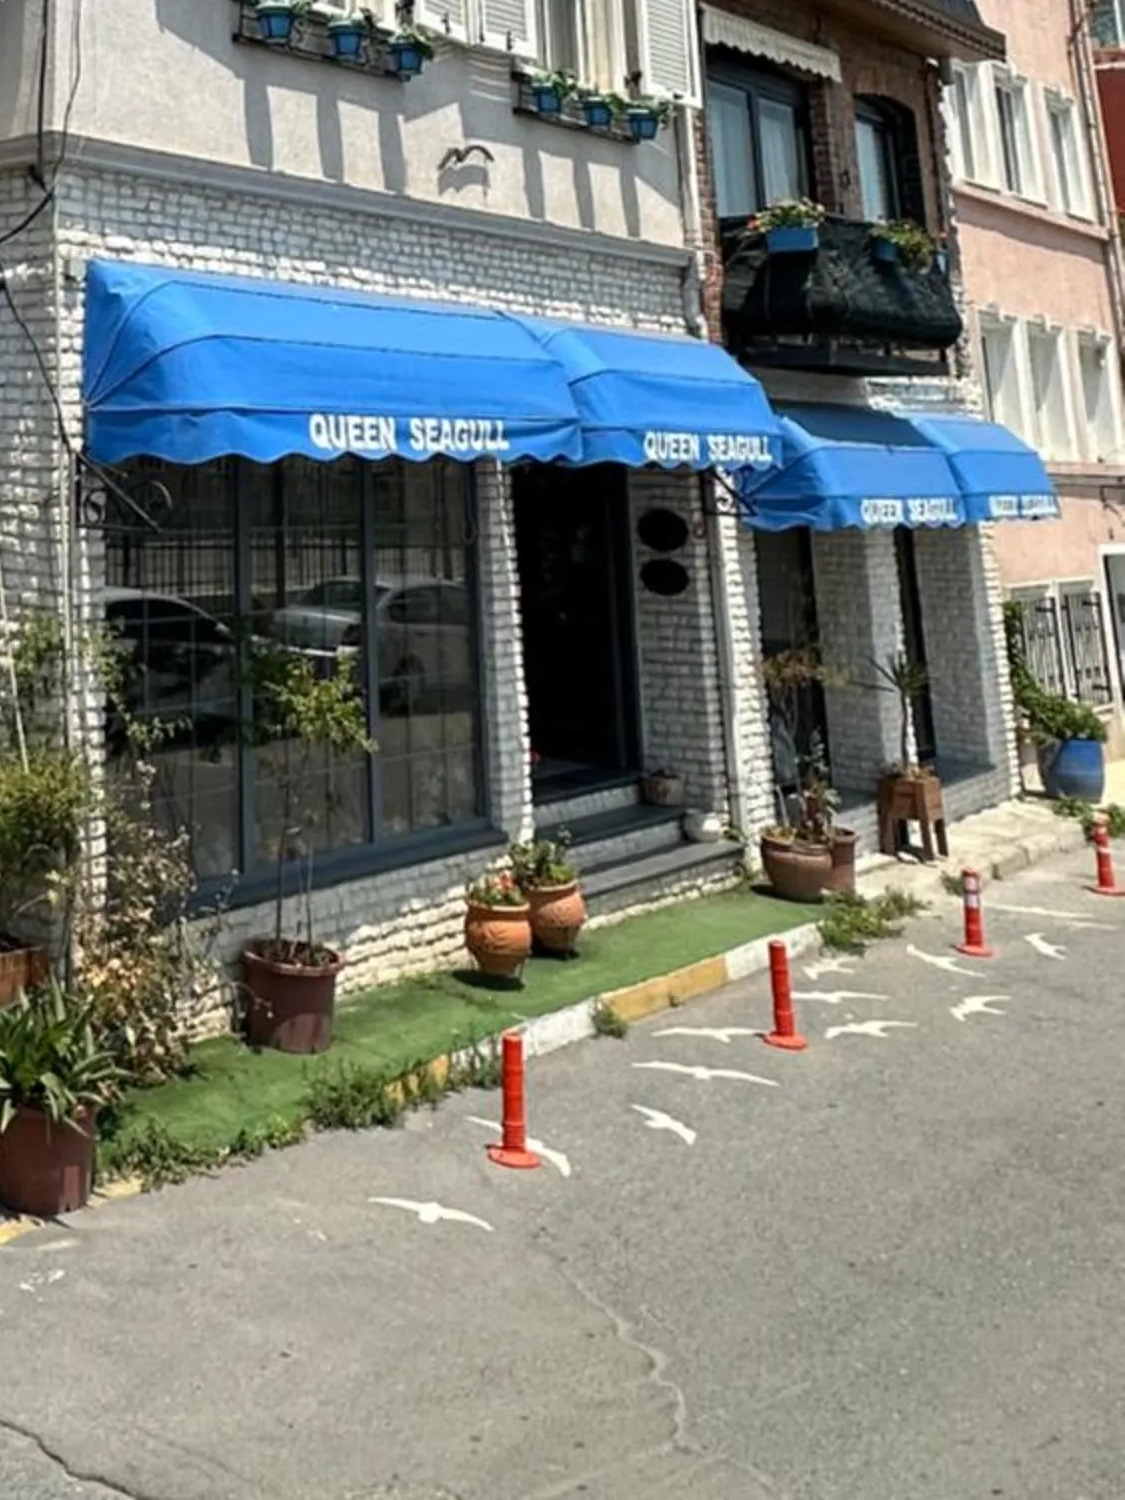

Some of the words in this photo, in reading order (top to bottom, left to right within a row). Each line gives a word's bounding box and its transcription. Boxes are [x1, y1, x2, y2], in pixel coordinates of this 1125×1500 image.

[309, 413, 398, 450] QUEEN
[409, 417, 510, 450] SEAGULL
[643, 431, 700, 461] QUEEN
[706, 434, 773, 461] SEAGULL
